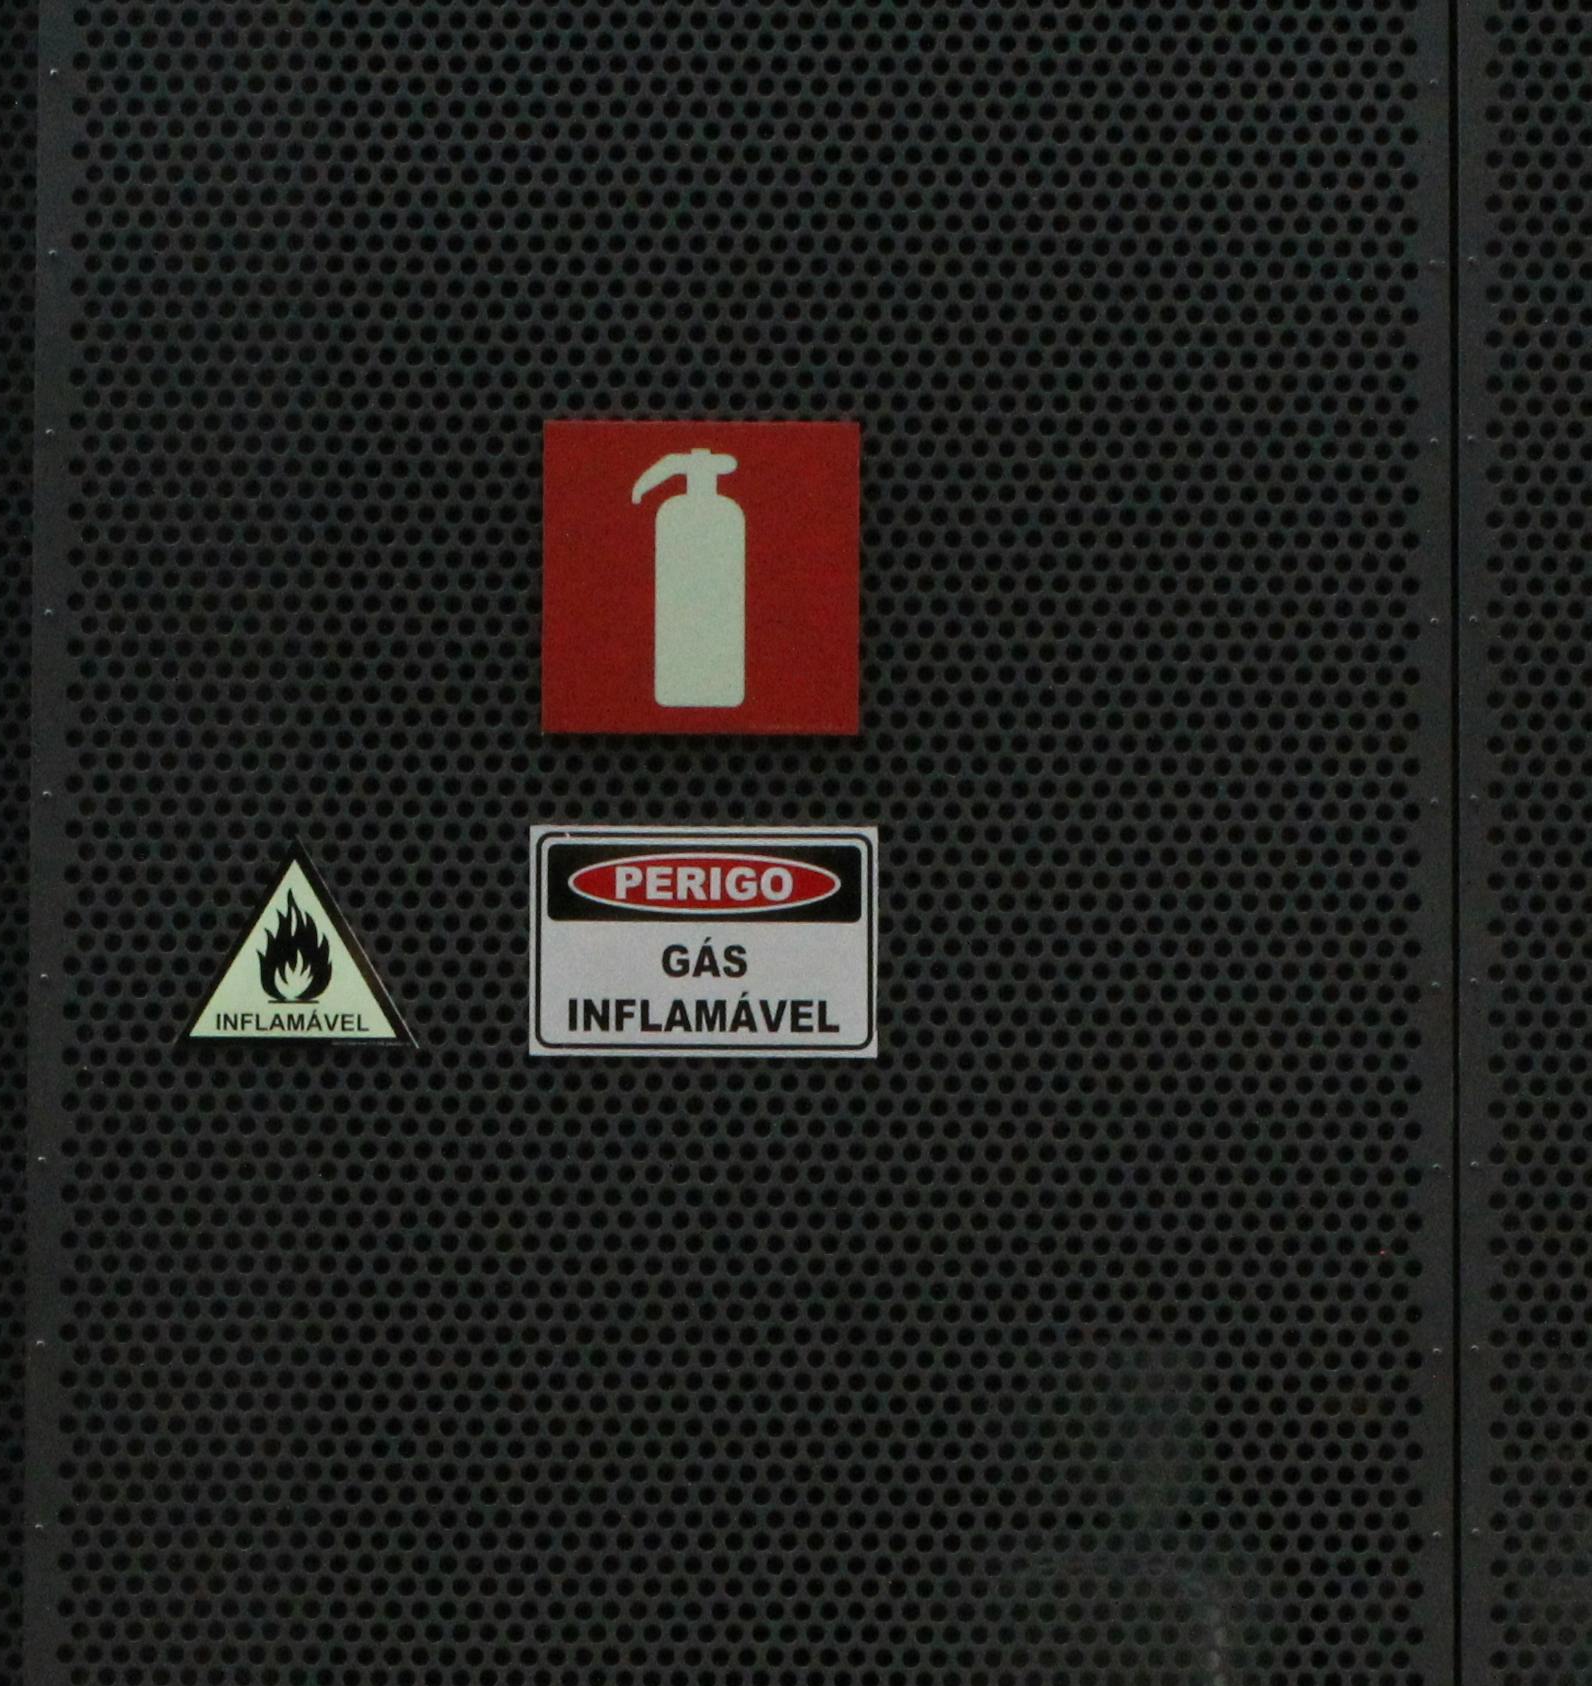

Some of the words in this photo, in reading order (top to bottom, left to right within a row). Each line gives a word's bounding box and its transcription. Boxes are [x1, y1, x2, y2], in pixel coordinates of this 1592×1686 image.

[615, 866, 794, 902] PERIGO
[662, 936, 748, 979] GÁS
[216, 1009, 369, 1033] INFLAMÁVEL
[568, 990, 840, 1034] INFLAMÁVEL
